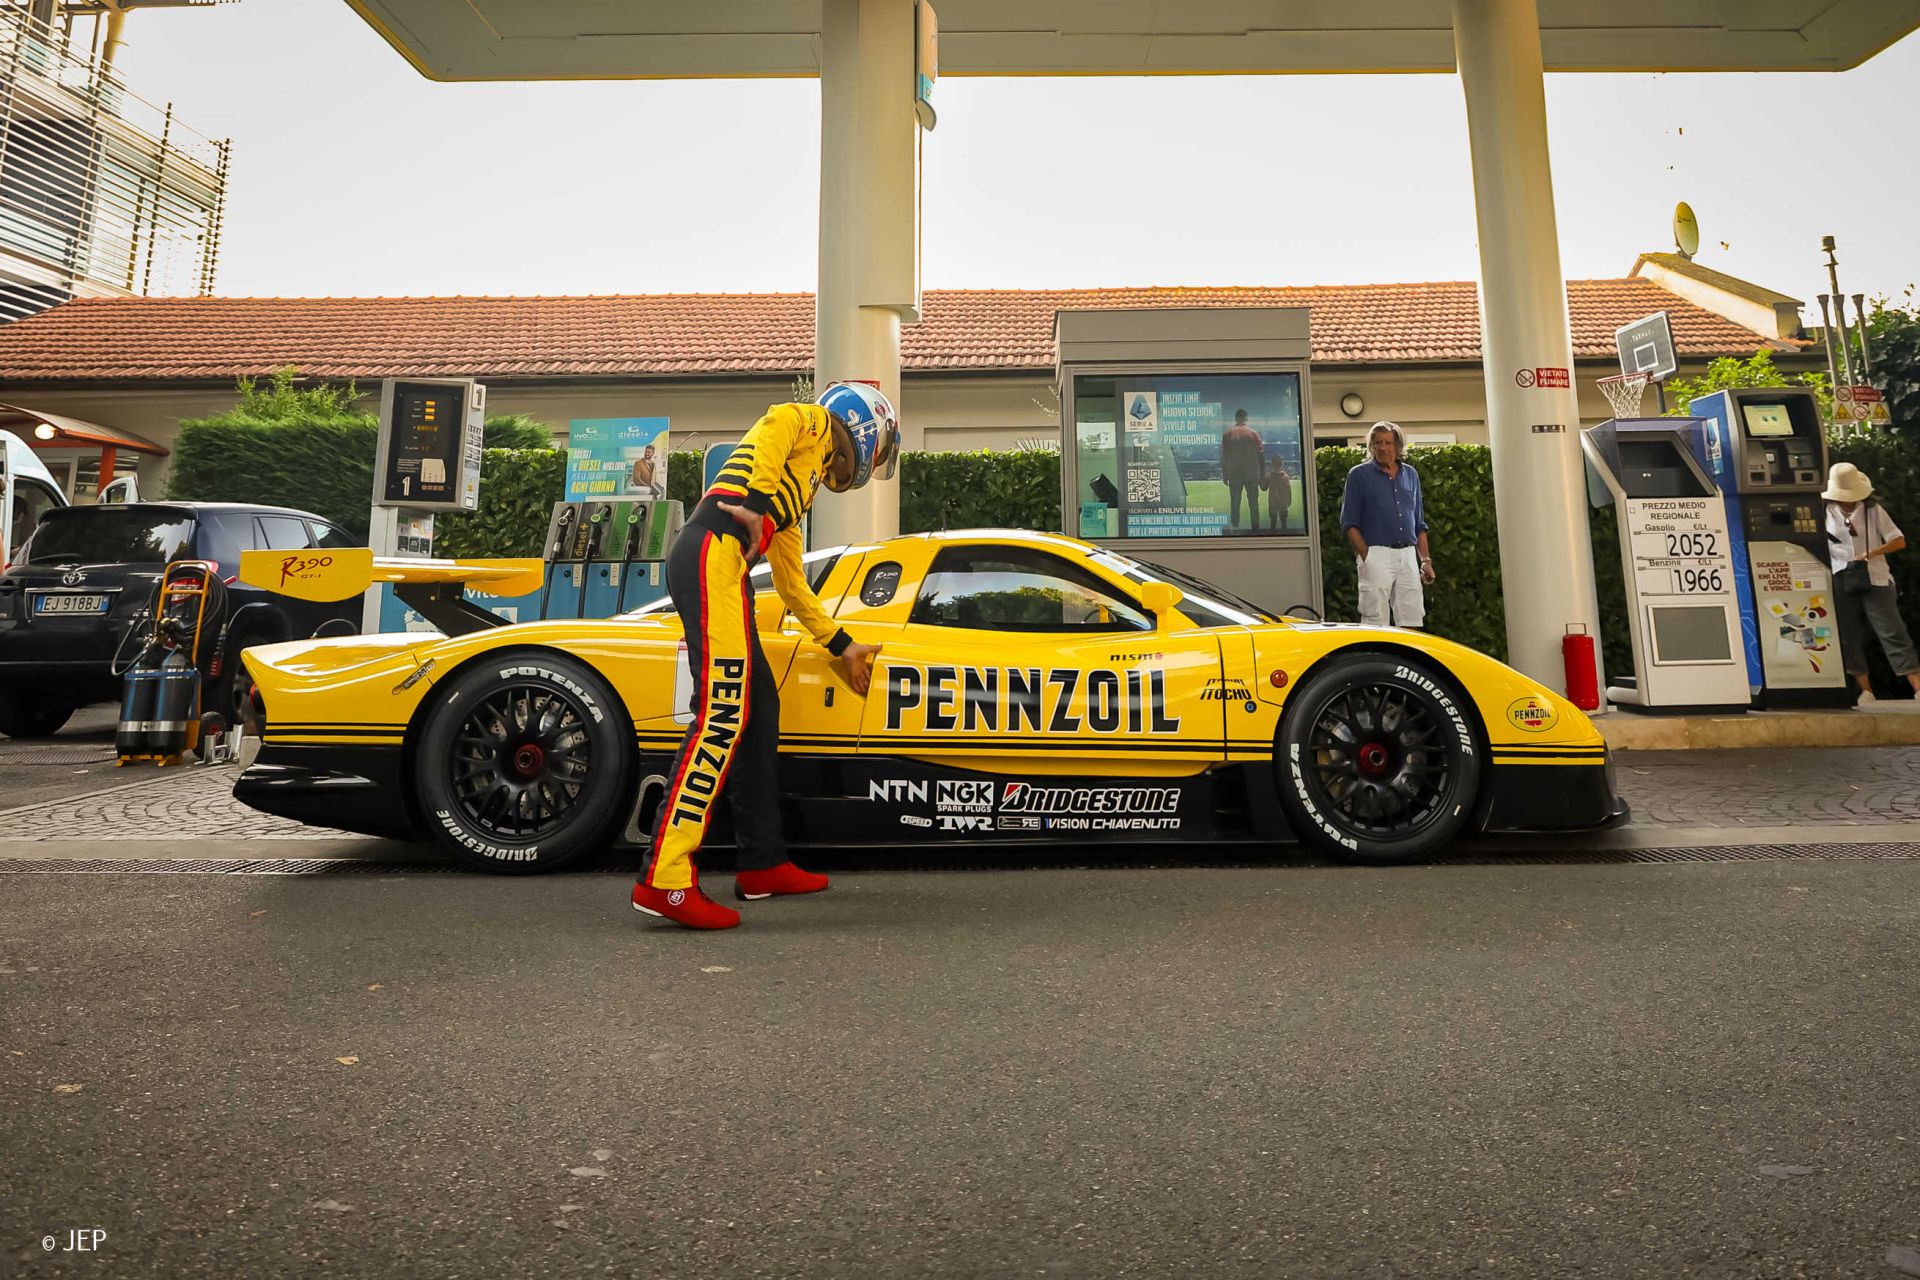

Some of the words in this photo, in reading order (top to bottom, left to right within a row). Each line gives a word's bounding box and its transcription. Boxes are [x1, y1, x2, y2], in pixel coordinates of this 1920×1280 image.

[1184, 393, 1199, 403] UNA
[1162, 406, 1187, 417] NUOVA
[1163, 421, 1186, 431] VIVILA
[402, 476, 411, 497] 1
[1642, 502, 1676, 510] PREZZO
[1650, 512, 1701, 520] REGIONALE
[1644, 524, 1676, 532] Gasolio
[576, 522, 588, 556] diesel+
[280, 556, 333, 588] R390
[43, 597, 60, 610] EJ
[62, 597, 101, 610] 918BJ
[499, 666, 604, 724] POTENZA
[883, 664, 1182, 735] PENNZOIL
[1200, 688, 1252, 700] ITOCHU
[1394, 665, 1474, 757] BRIDGESTONE
[1514, 708, 1552, 720] PENNZOIL
[672, 657, 746, 829] PENNZOIL
[869, 779, 928, 803] NTN
[937, 781, 994, 805] NGK
[998, 782, 1181, 813] BRIDGESTONE
[1290, 743, 1358, 851] POTENZA
[936, 816, 995, 831] TWR
[1092, 818, 1181, 830] CHIAVENUTO
[436, 809, 538, 862] BRIDGESTONE
